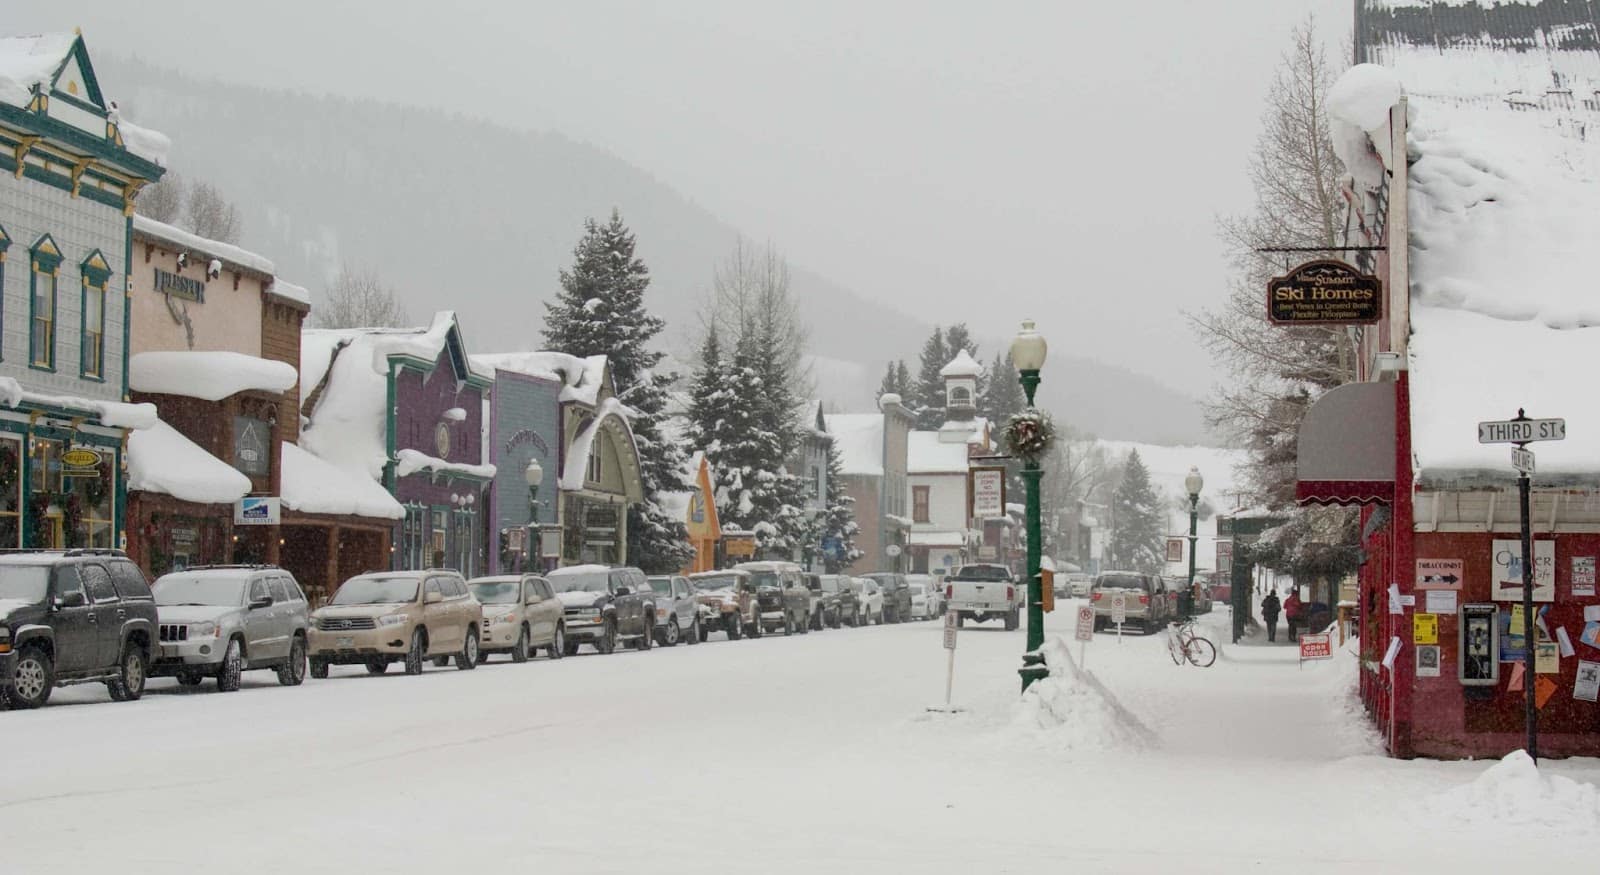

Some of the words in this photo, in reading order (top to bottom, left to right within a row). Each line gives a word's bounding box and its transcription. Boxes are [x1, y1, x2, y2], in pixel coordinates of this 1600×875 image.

[1276, 287, 1304, 300] Ski
[1311, 287, 1373, 300] Homes
[1487, 423, 1532, 440] THIRD
[1304, 643, 1327, 651] open
